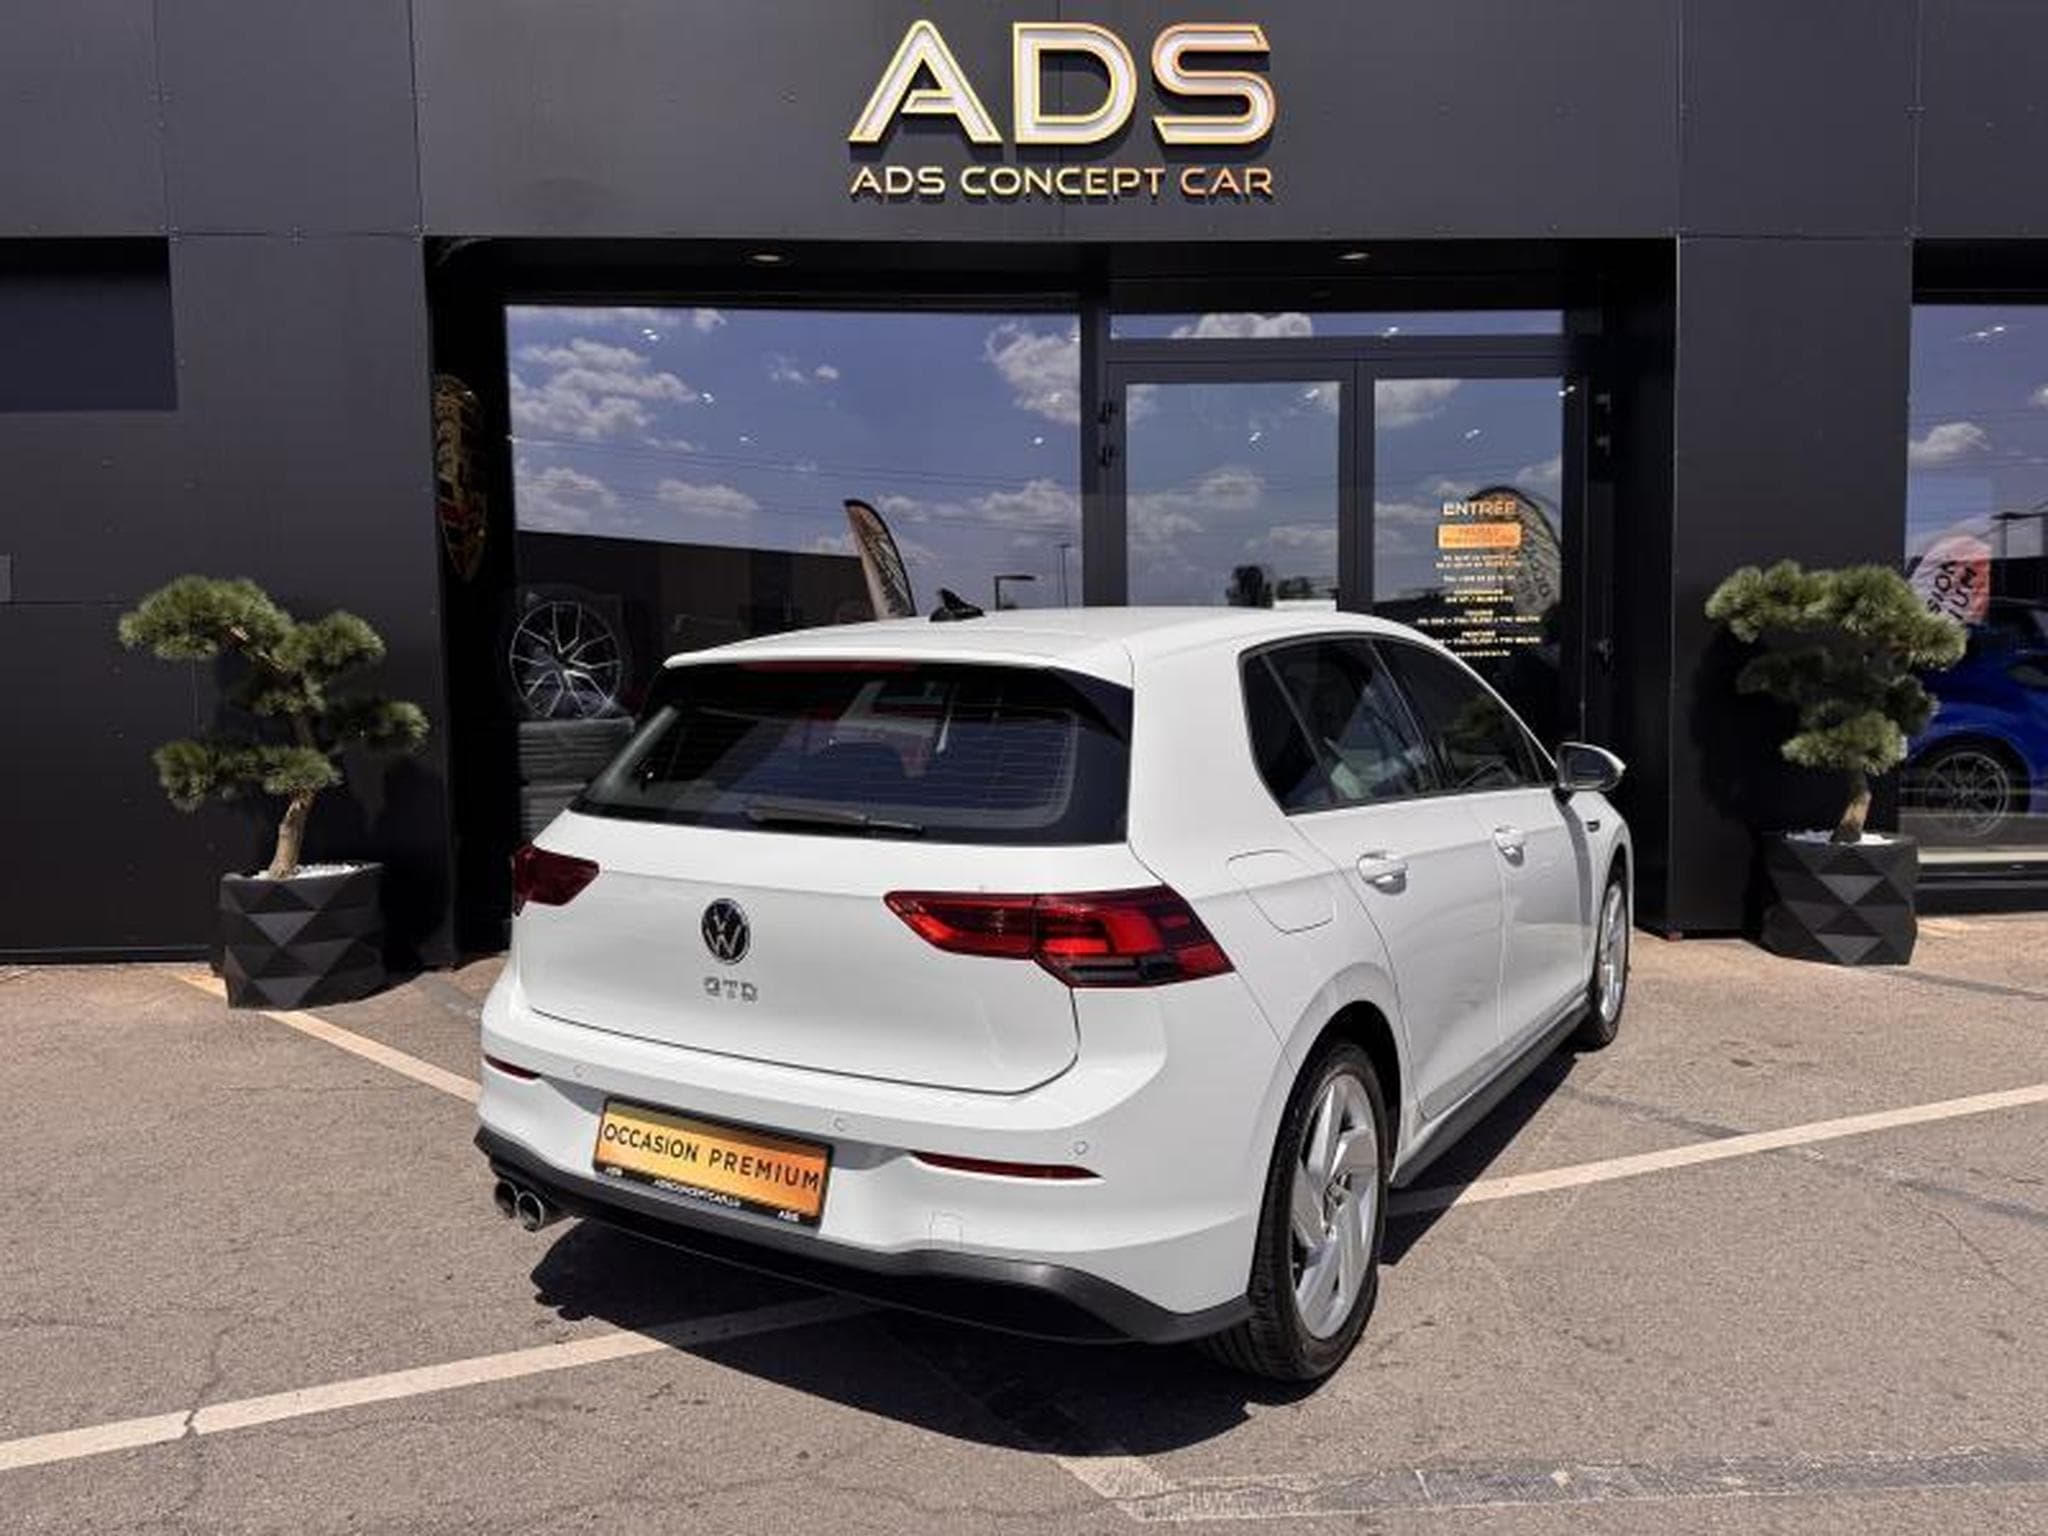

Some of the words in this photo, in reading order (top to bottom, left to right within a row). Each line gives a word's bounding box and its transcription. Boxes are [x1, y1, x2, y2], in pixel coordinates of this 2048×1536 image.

[848, 20, 1276, 144] ADS
[850, 166, 946, 195] ADS
[961, 166, 1166, 195] CONCEPT
[1180, 167, 1275, 195] CAR
[603, 1123, 701, 1162] OCCASION
[708, 1149, 820, 1192] PREMIUM
